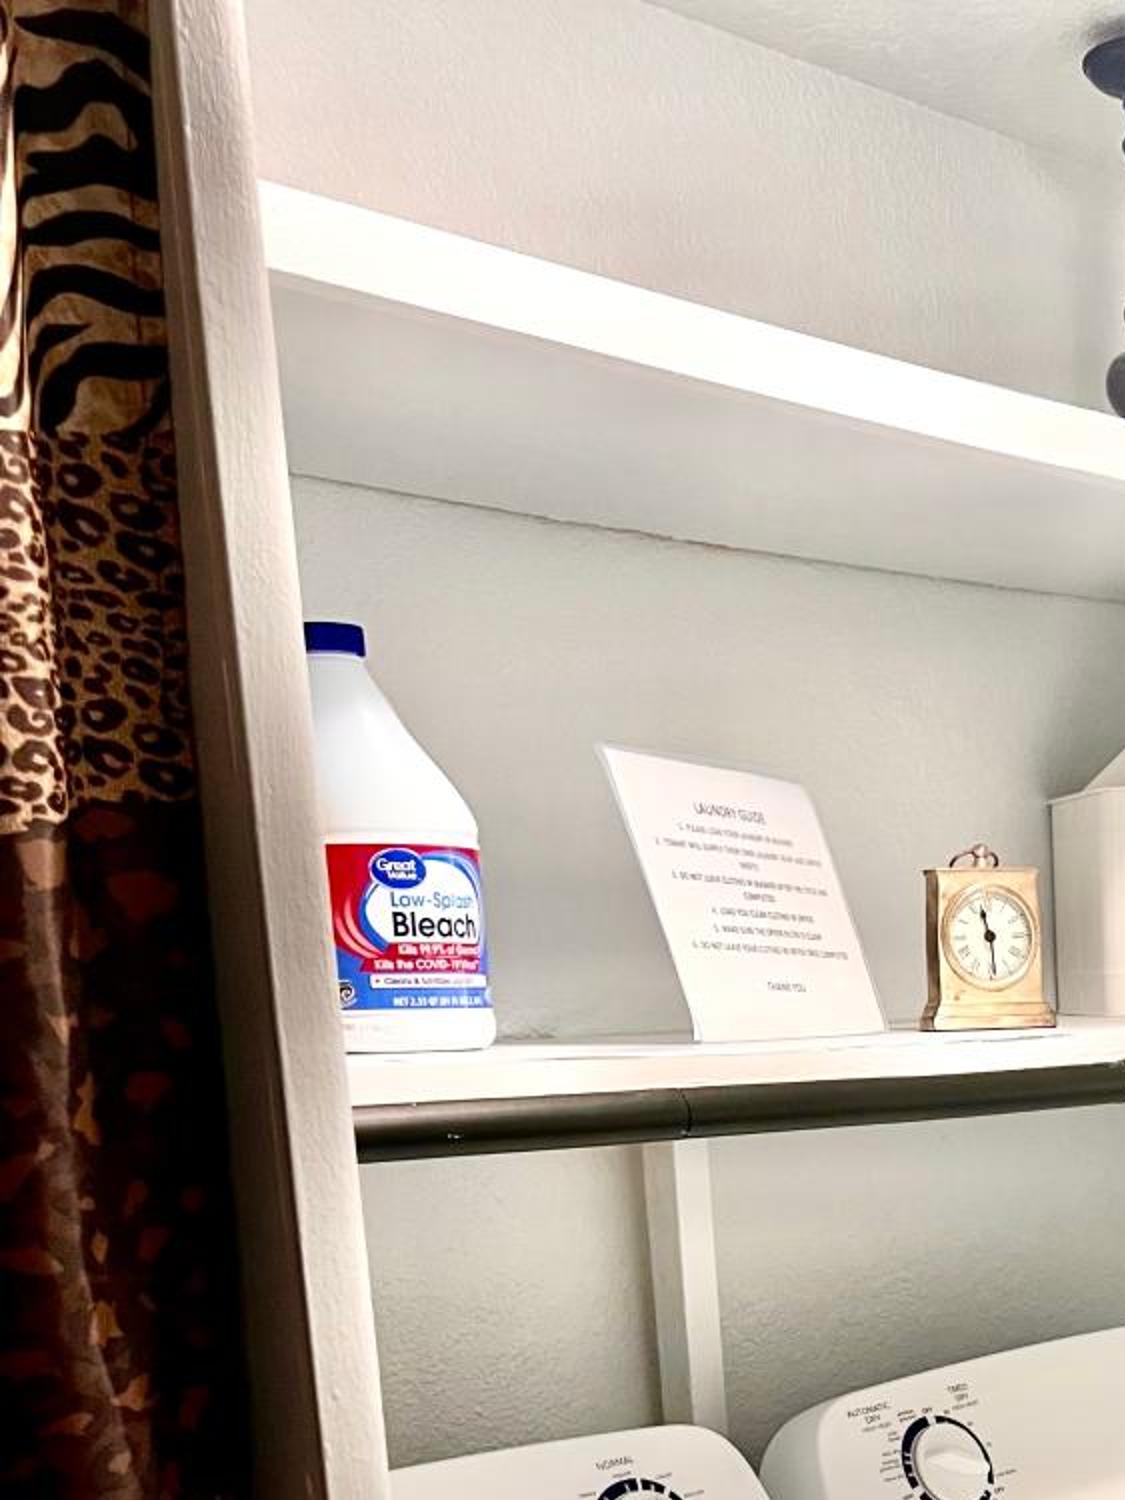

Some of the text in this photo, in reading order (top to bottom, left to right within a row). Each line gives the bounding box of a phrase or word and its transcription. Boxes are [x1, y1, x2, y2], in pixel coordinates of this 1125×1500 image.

[376, 858, 417, 873] Great
[388, 870, 418, 881] Value
[391, 911, 477, 938] Bleach
[396, 959, 414, 970] the
[848, 1401, 892, 1418] AUTOMATIC
[595, 1456, 635, 1471] NORMAL
